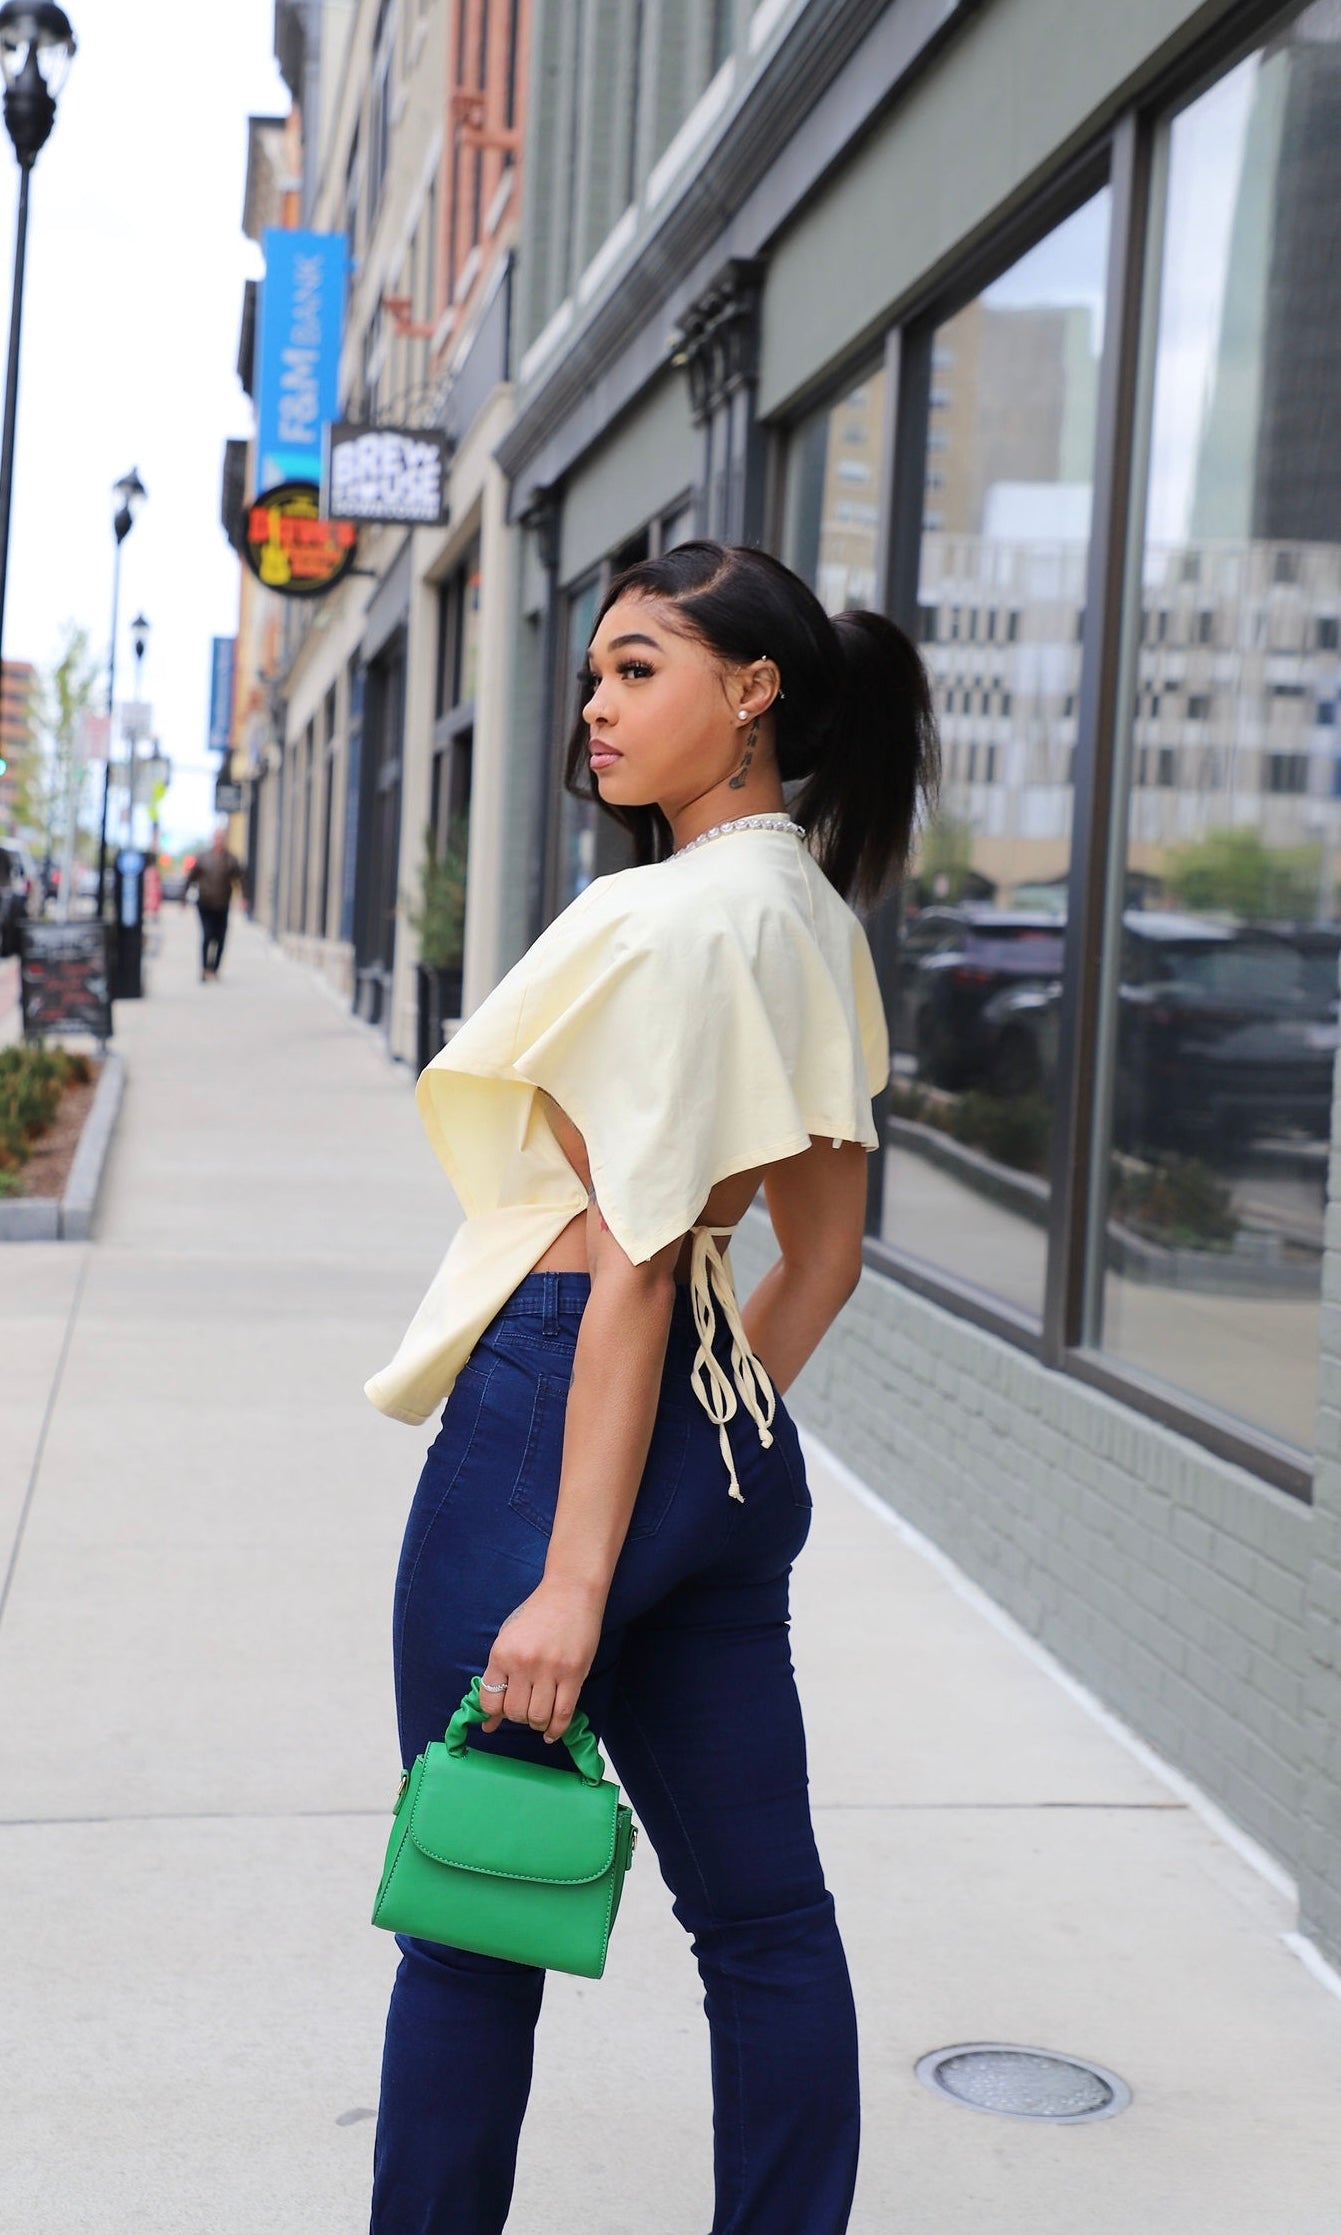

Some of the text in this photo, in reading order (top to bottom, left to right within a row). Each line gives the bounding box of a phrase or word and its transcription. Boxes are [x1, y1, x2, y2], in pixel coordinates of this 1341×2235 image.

[278, 253, 323, 443] F&M BANK
[332, 431, 441, 483] BREW
